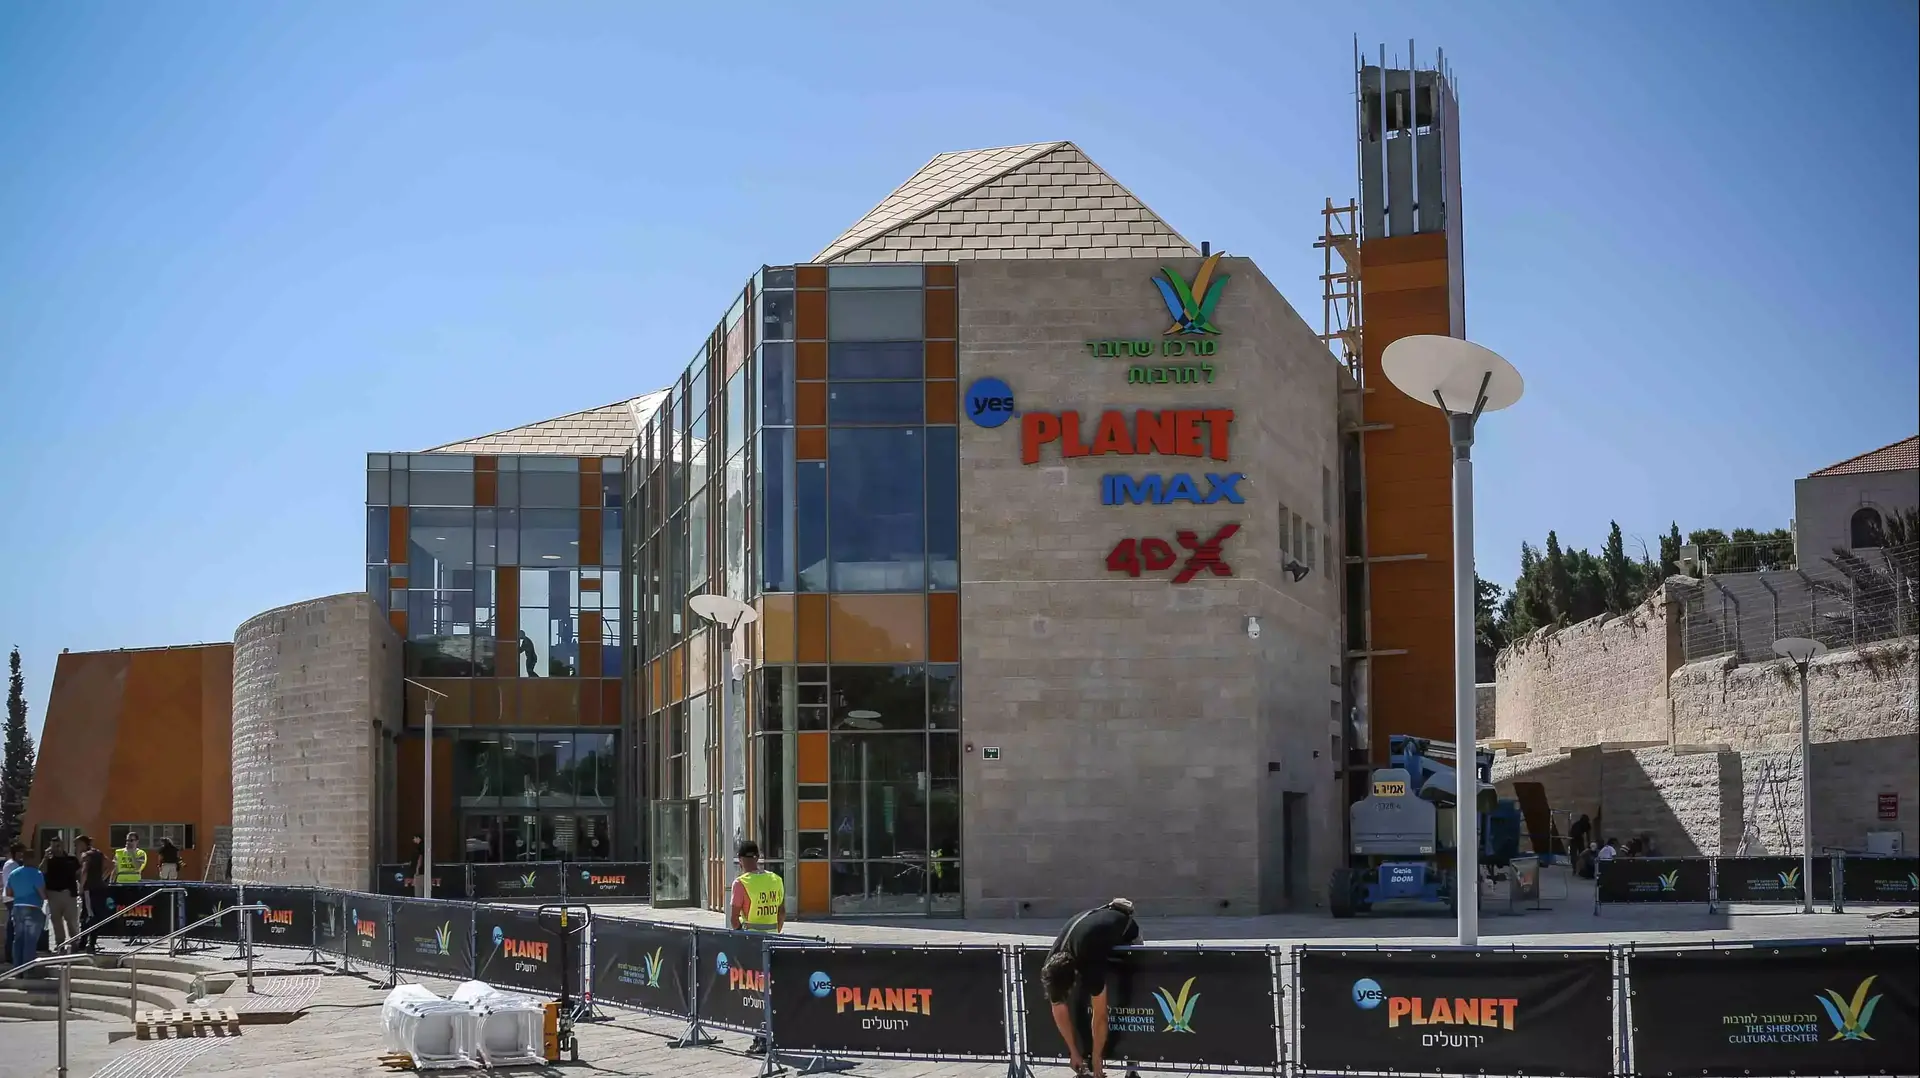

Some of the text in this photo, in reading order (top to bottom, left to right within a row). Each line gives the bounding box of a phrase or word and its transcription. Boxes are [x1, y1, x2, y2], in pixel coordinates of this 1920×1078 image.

[1086, 340, 1217, 357] מרכז שרובר
[1128, 363, 1214, 384] לתרבות
[1021, 409, 1234, 465] PLANET
[1101, 473, 1245, 505] IMAX
[1105, 524, 1240, 583] 4DX
[591, 875, 626, 885] PLANET
[504, 938, 548, 963] PLANET
[730, 967, 765, 993] PLAN
[743, 995, 765, 1010] רושלים
[836, 987, 932, 1016] PLANET
[1118, 1016, 1154, 1024] SHEROVER
[1388, 996, 1518, 1031] PLANET
[1723, 1012, 1817, 1024] מרכז שרובר לתרבות
[862, 1016, 909, 1030] ירושלים
[1745, 1023, 1818, 1033] THE SHEROVER
[1422, 1030, 1484, 1048] ירושלים
[1728, 1034, 1818, 1044] CULTURAL CENTER
